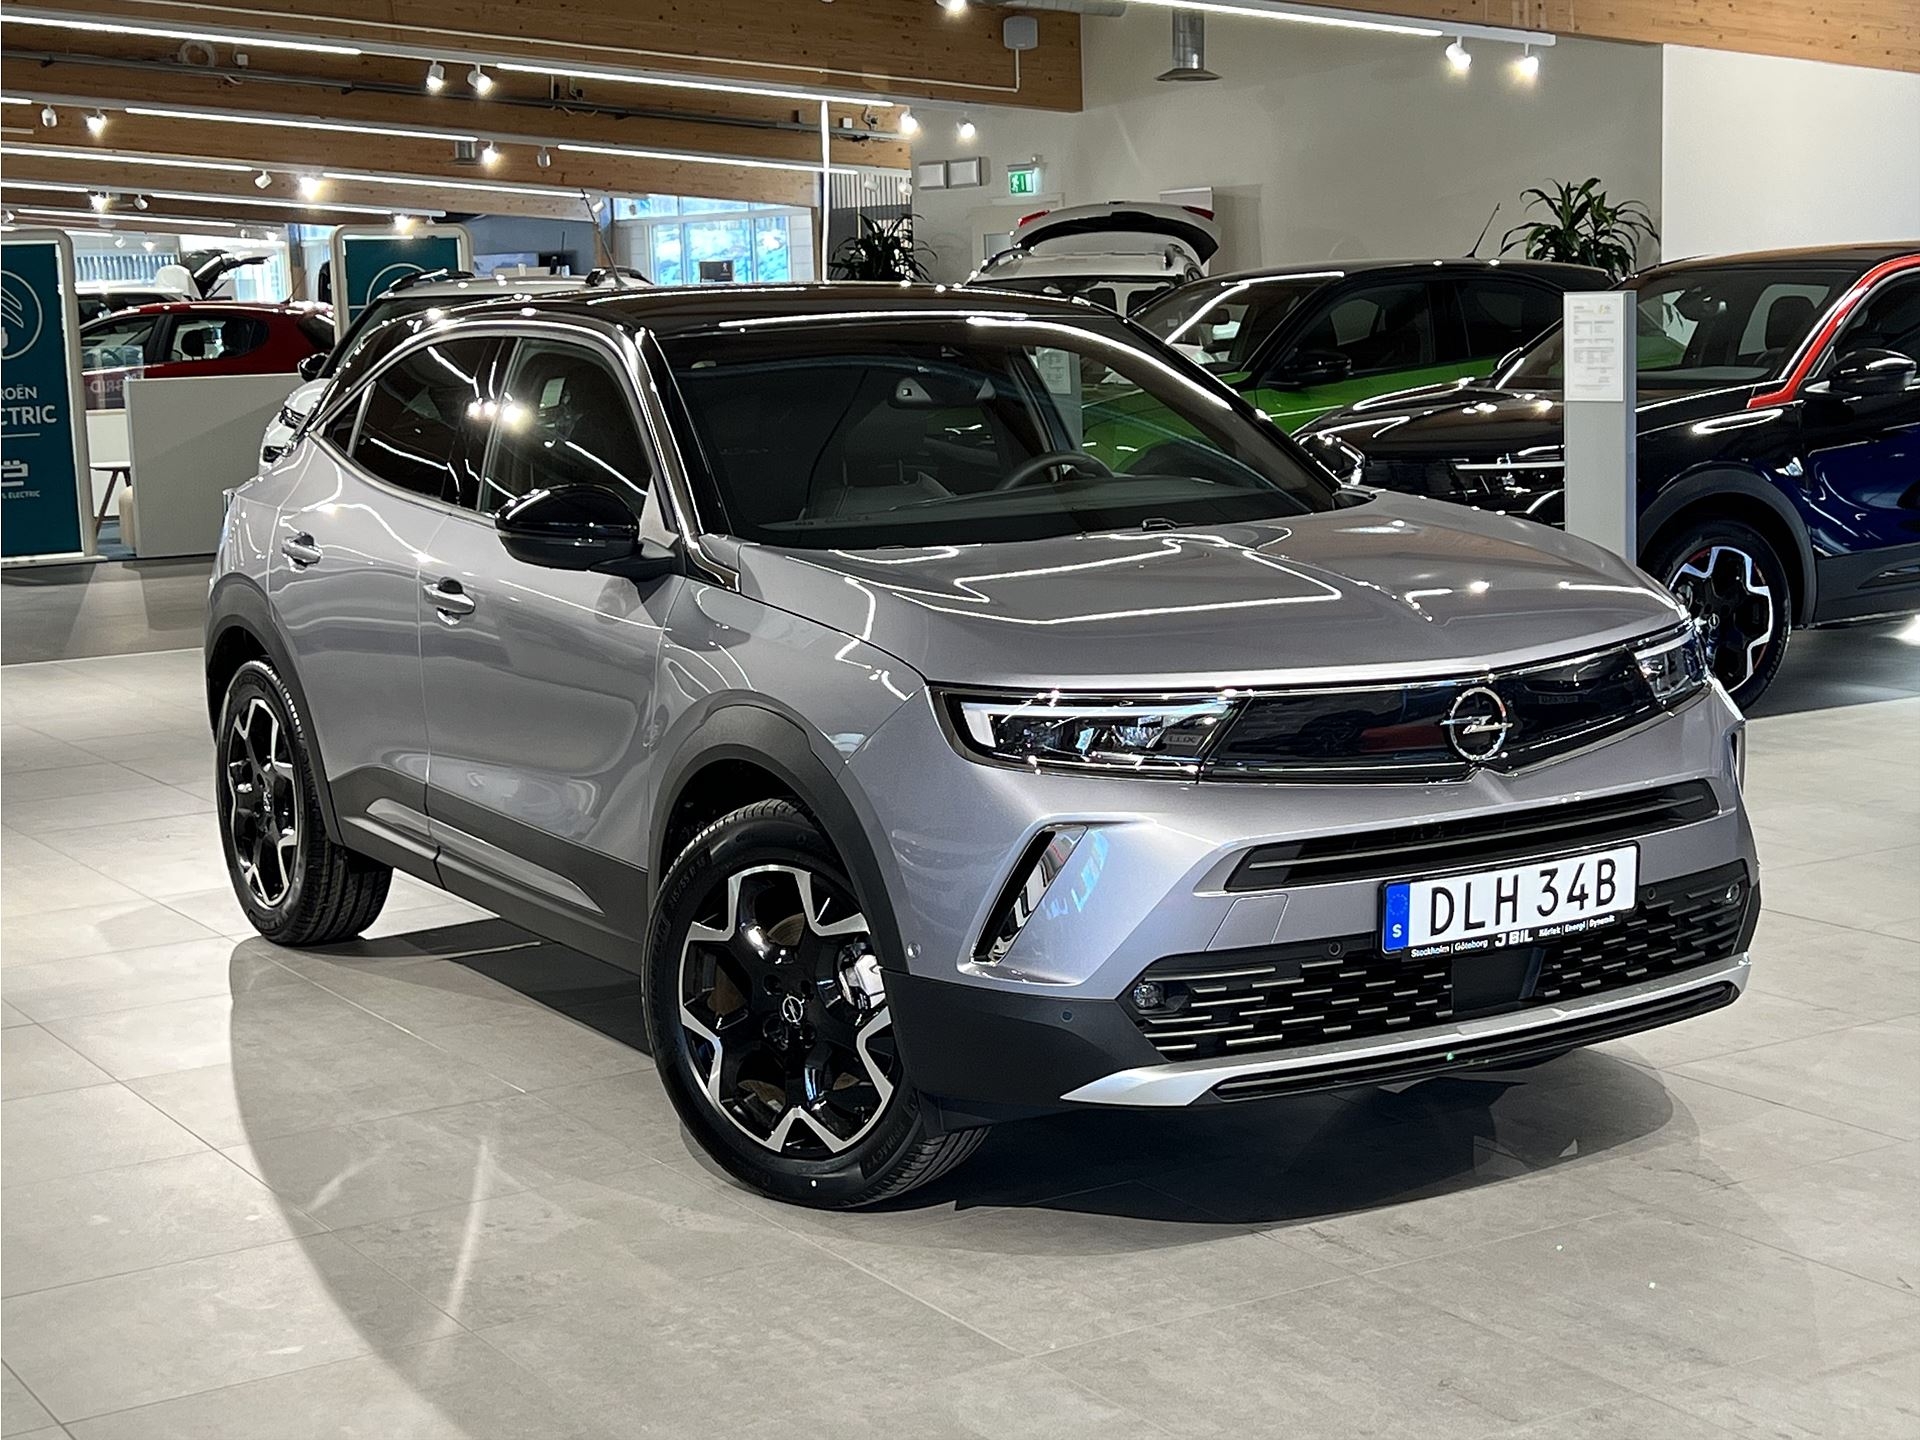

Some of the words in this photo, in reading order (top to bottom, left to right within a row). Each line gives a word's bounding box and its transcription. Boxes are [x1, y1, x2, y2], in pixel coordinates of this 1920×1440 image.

[1430, 874, 1520, 937] DLH
[1536, 858, 1617, 918] 34B
[1392, 923, 1403, 939] S
[1410, 944, 1451, 959] Stockholm
[1454, 939, 1489, 952] Göteborg
